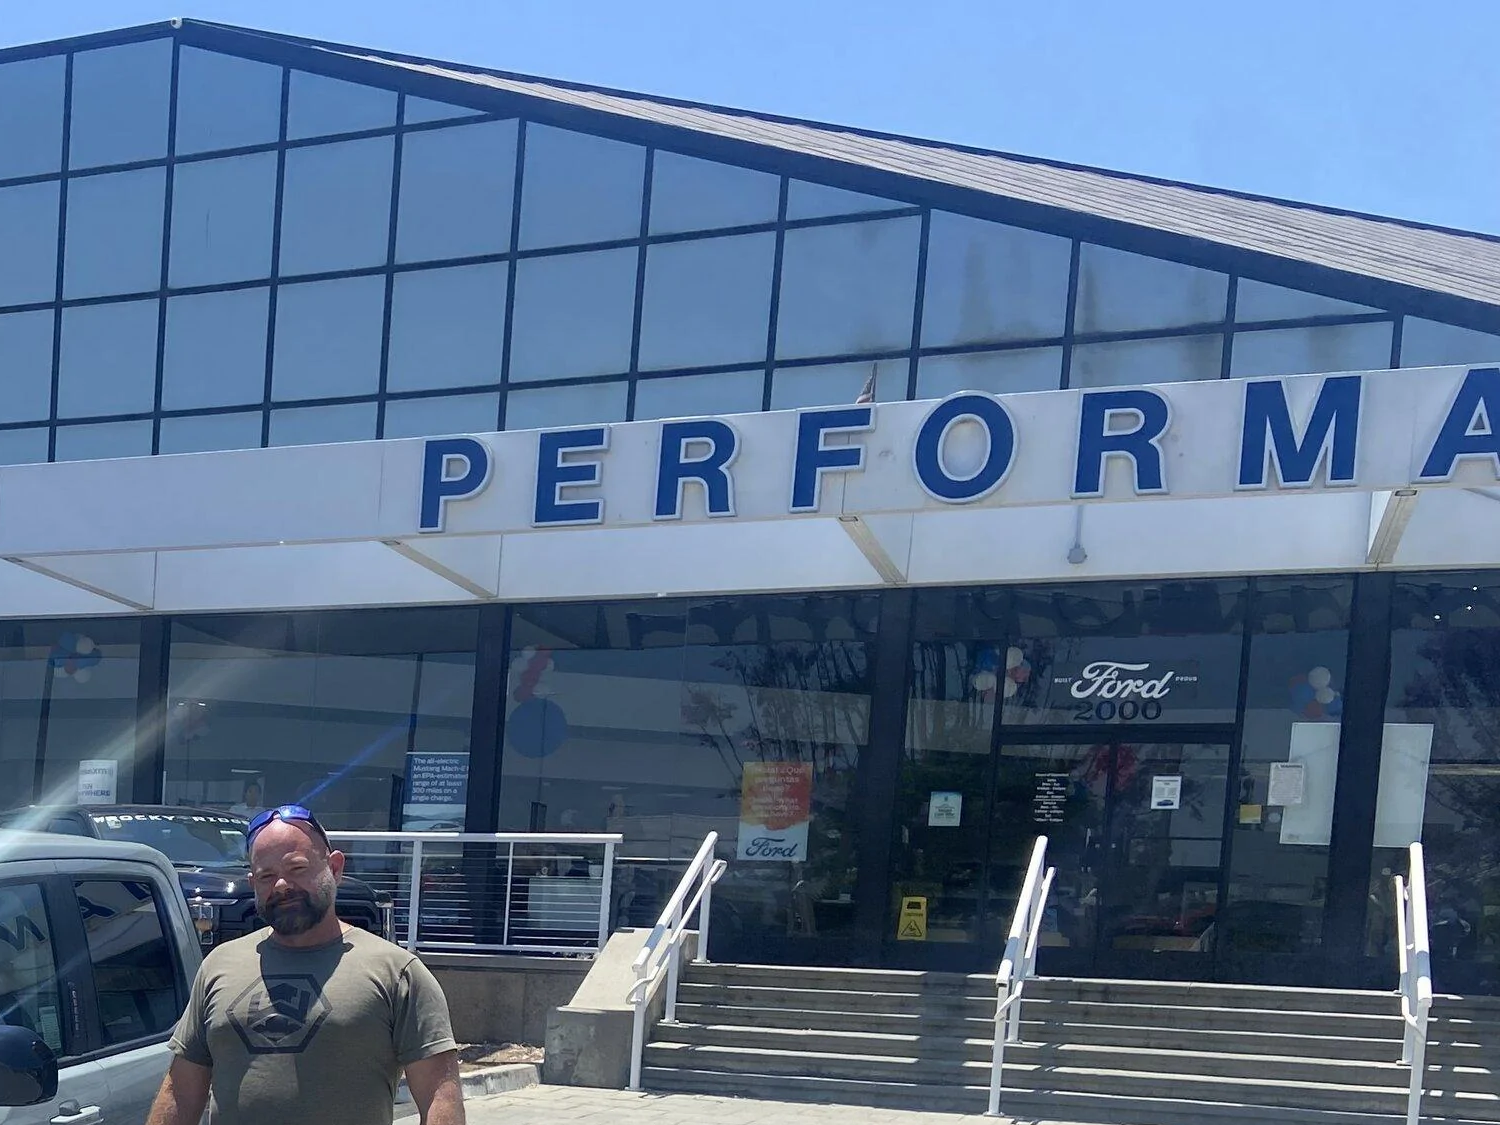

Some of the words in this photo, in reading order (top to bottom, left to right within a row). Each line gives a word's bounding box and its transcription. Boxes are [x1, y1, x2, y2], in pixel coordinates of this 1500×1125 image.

[417, 366, 1500, 533] PERFORMA
[1070, 661, 1175, 699] Ford
[1073, 700, 1162, 721] 2000
[745, 837, 798, 858] Ford
